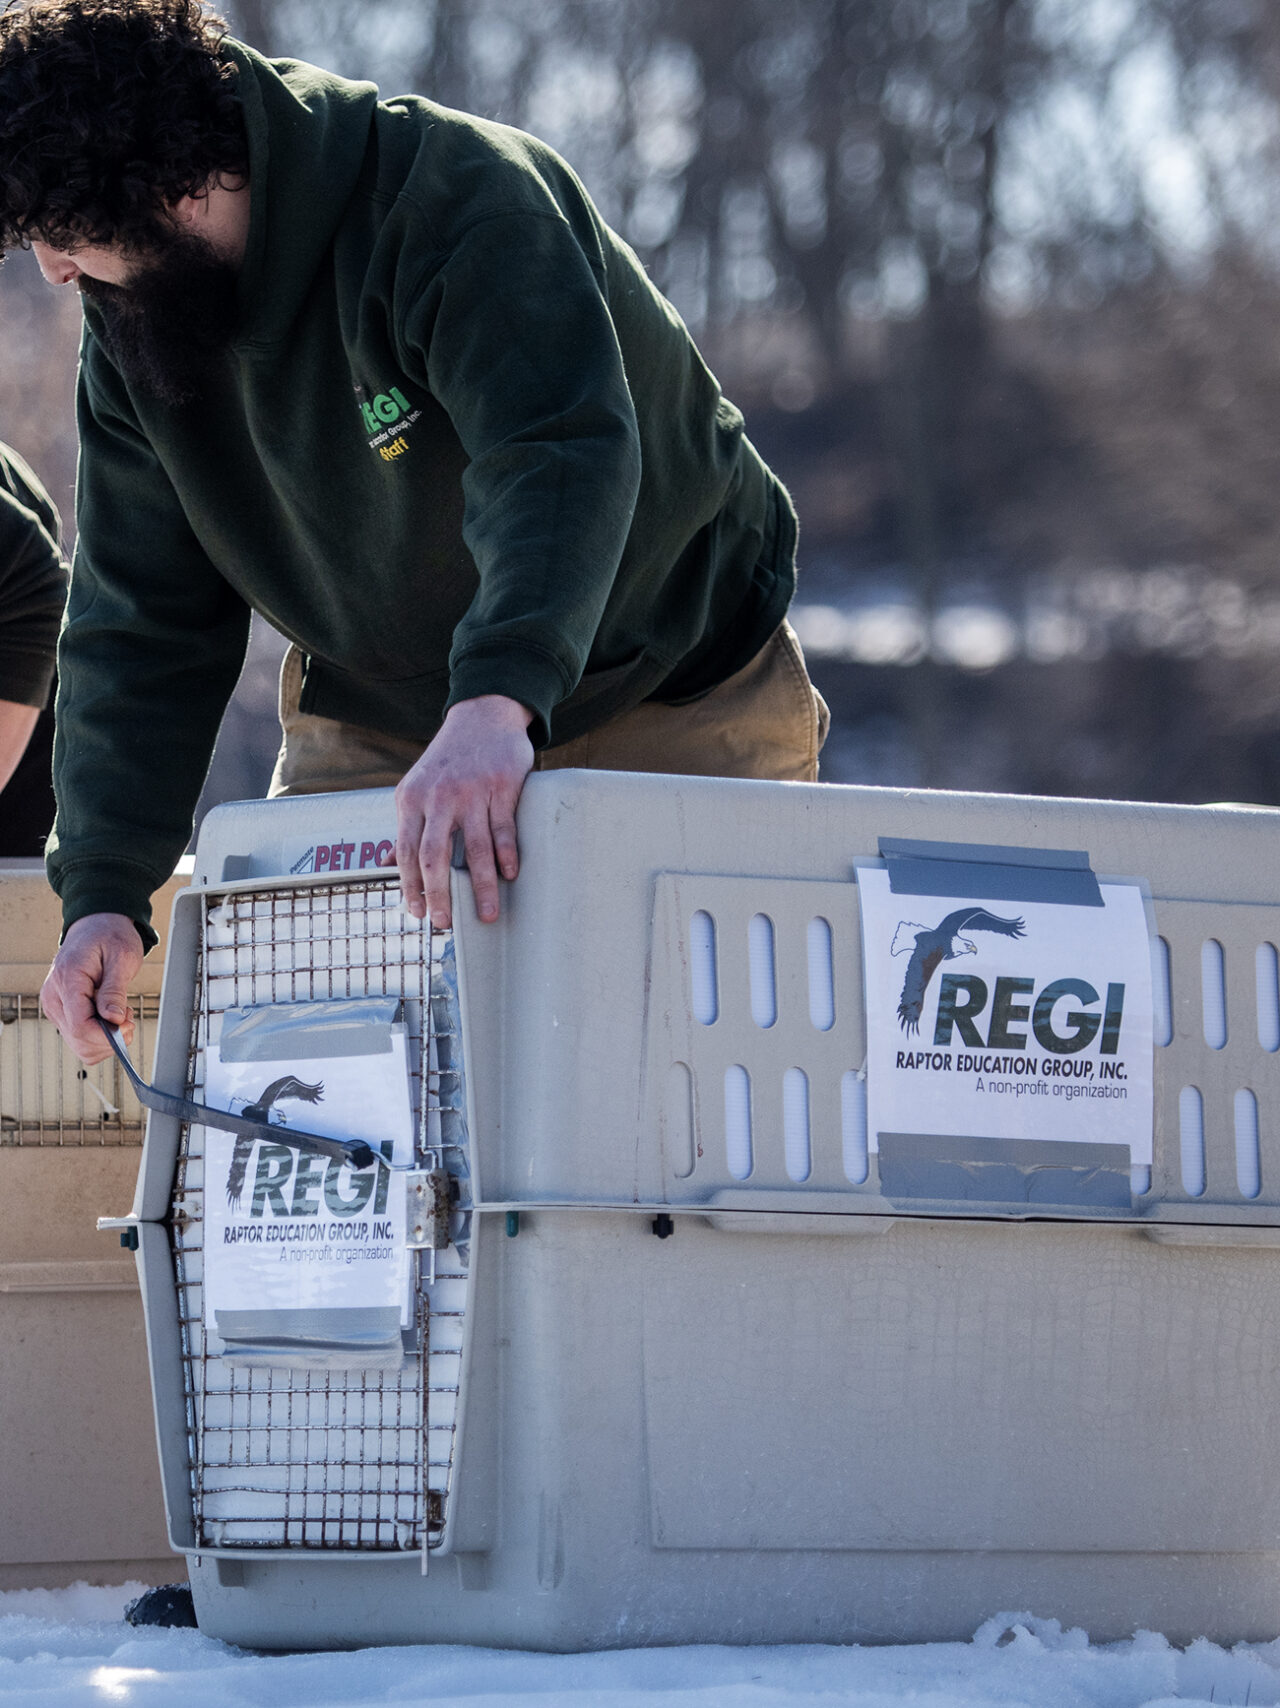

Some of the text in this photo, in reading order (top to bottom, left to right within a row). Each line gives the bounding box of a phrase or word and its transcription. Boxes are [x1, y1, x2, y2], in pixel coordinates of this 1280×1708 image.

[361, 386, 411, 434] EGI
[314, 840, 400, 872] PET PO
[933, 973, 1125, 1055] REGI
[896, 1051, 1128, 1080] RAPTOR EDUCATION GROUP, INC.
[975, 1077, 1127, 1101] A non-profit organization
[250, 1140, 394, 1217] REGI
[223, 1221, 394, 1244] RAPTOR EDUCATION GROUP, INC.
[279, 1244, 394, 1264] A non-profit organization
